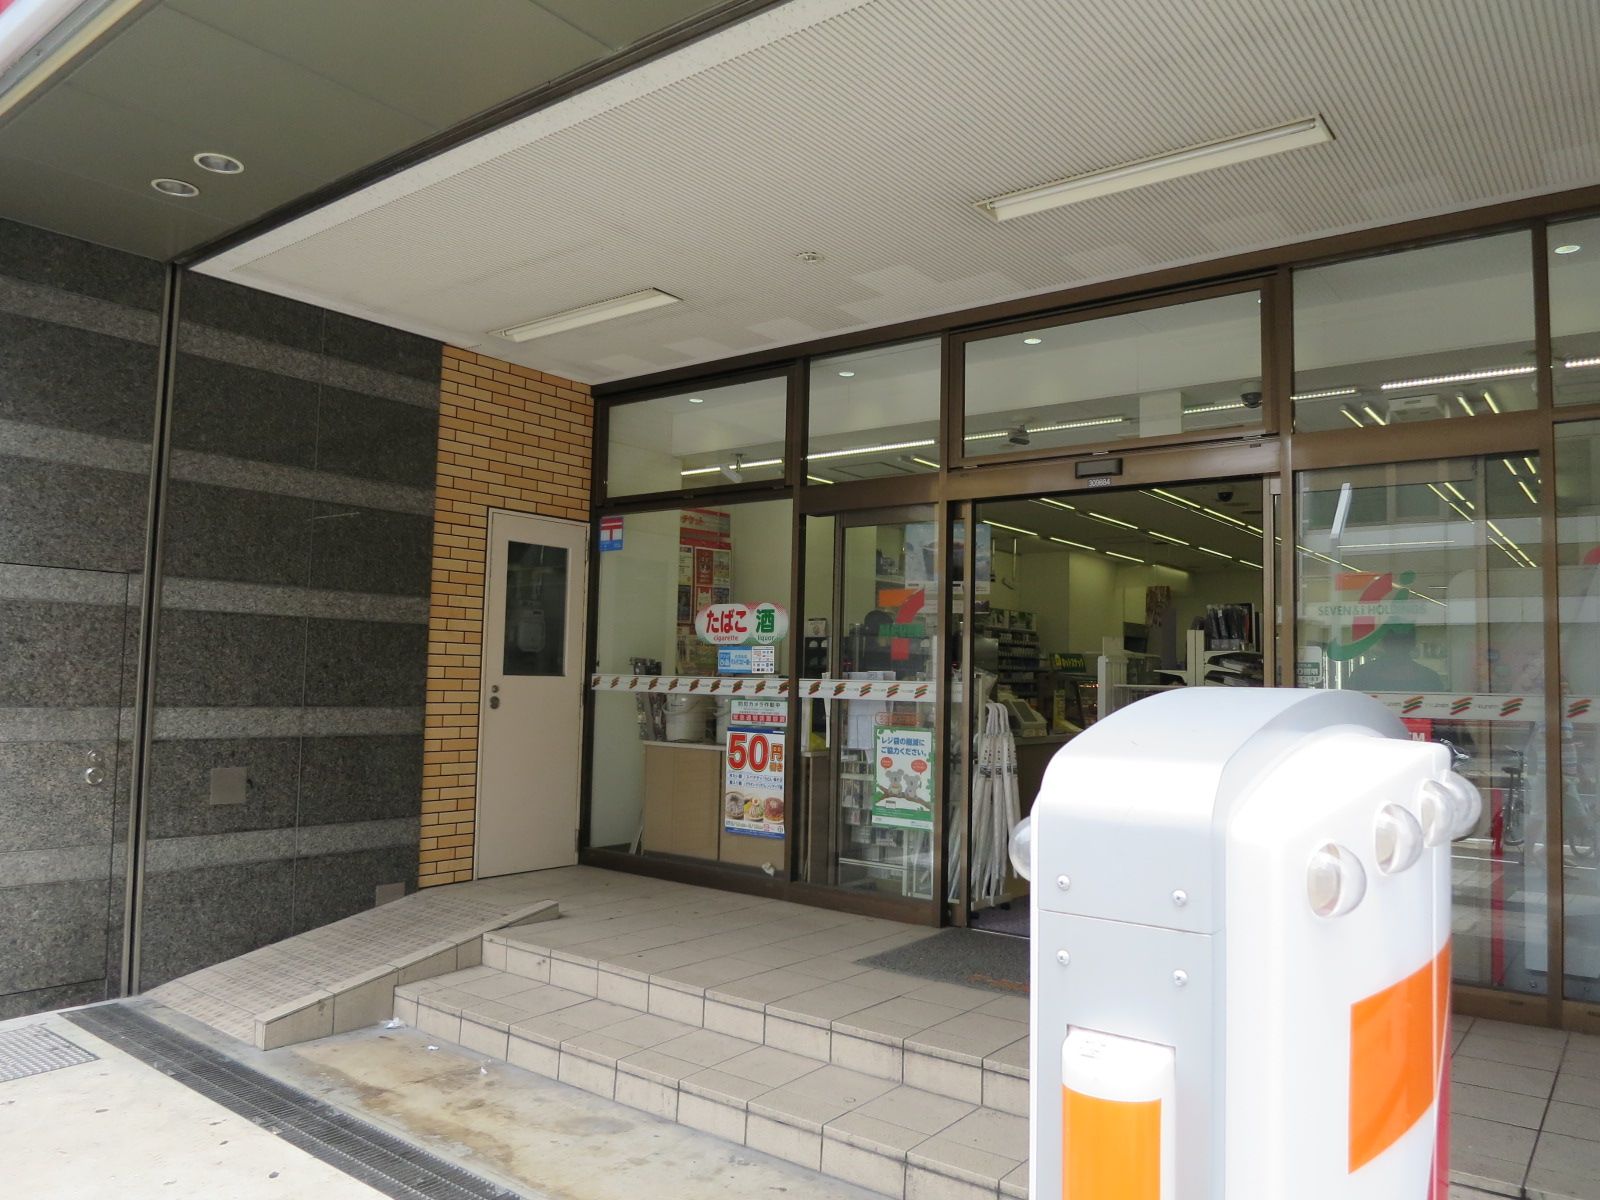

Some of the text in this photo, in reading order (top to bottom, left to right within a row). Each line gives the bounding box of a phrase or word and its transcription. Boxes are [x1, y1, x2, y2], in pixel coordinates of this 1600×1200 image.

[706, 609, 775, 633] たばこ 酒
